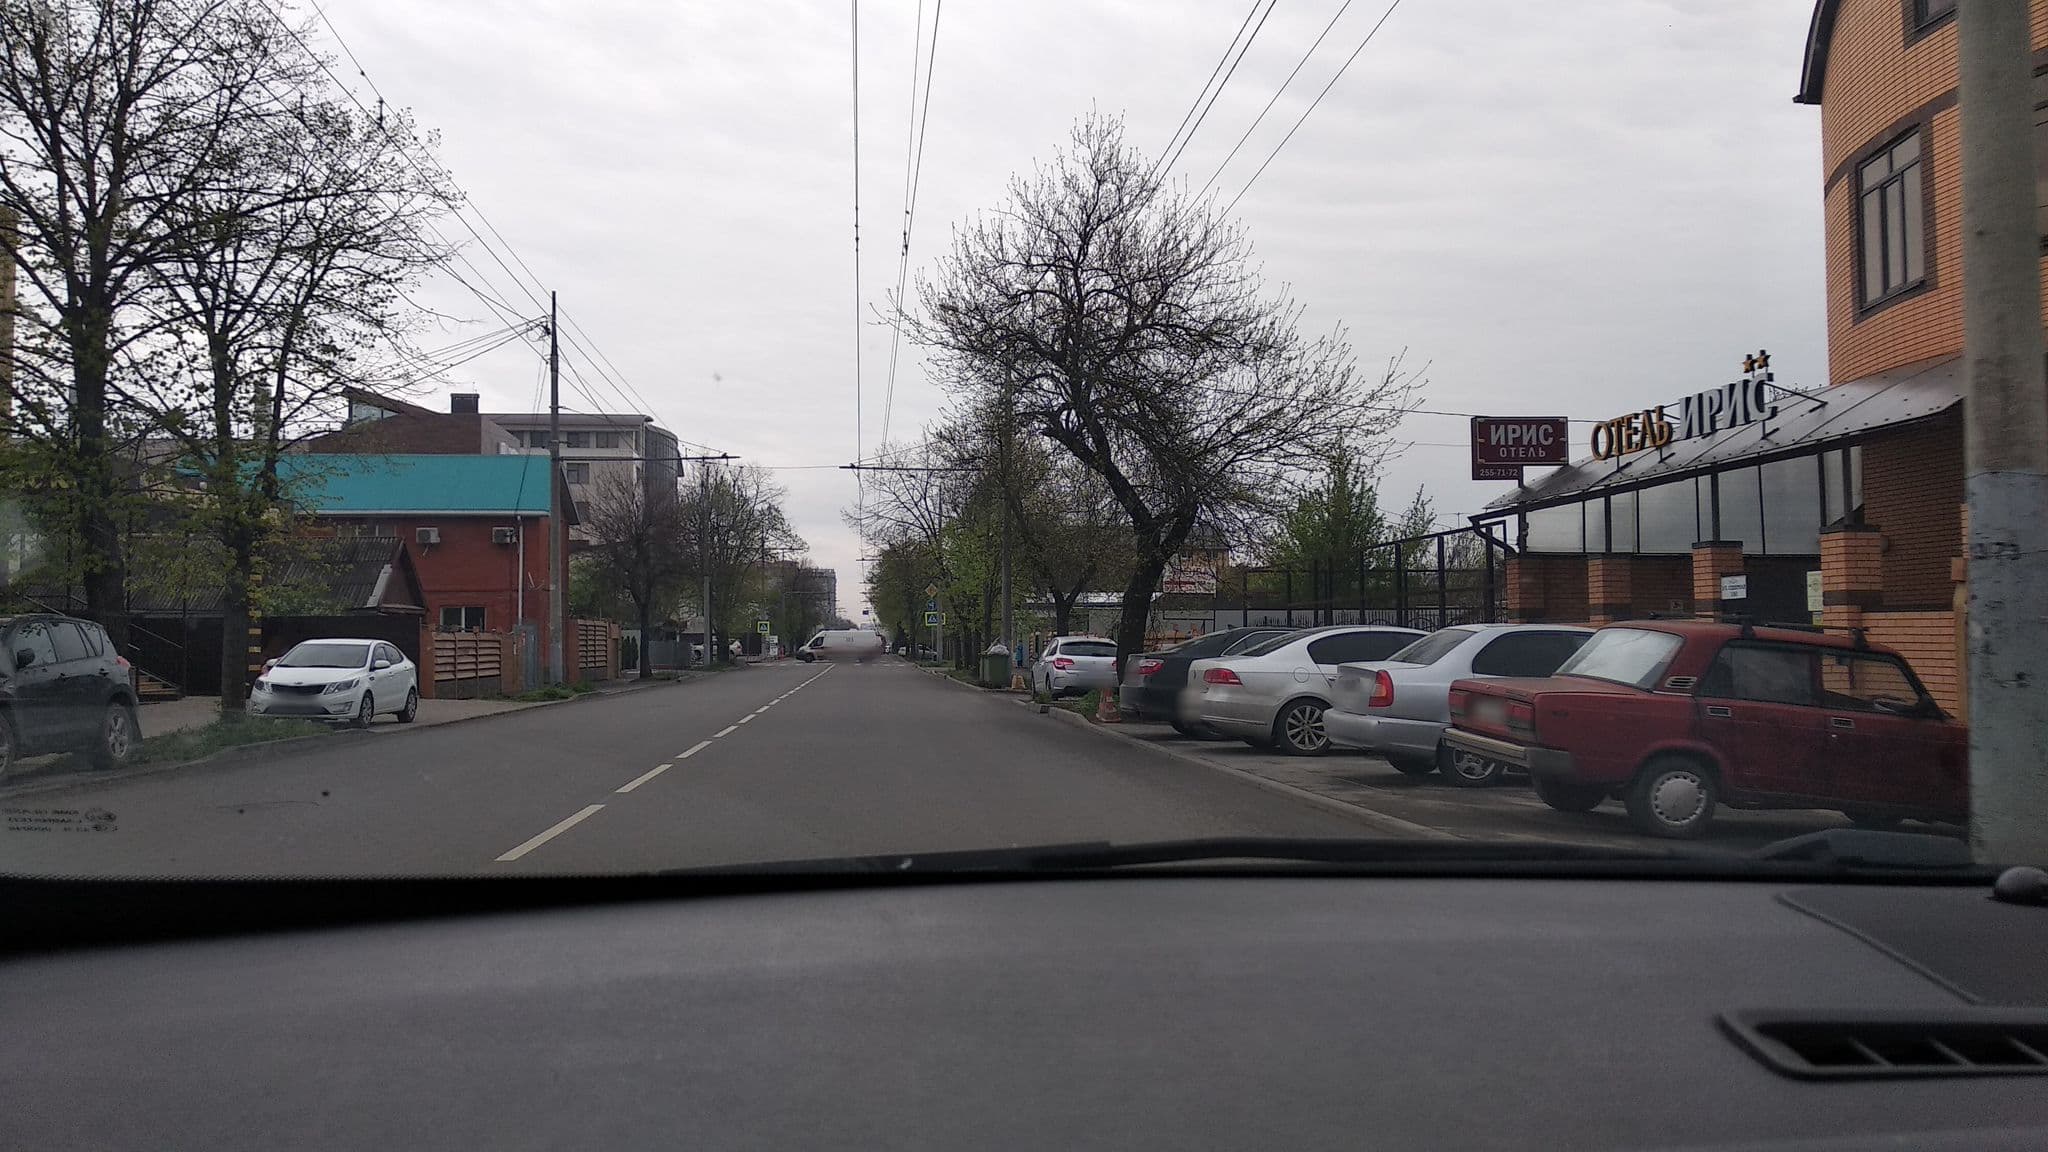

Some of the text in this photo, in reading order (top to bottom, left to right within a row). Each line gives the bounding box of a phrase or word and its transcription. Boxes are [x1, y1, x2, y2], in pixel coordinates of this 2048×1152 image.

[1591, 372, 1778, 461] ОТЕЛЬ ИРИС
[1490, 424, 1553, 446] ИРИС
[1500, 447, 1546, 458] ОТЕЛЬ
[1479, 468, 1518, 477] 255-71-72
